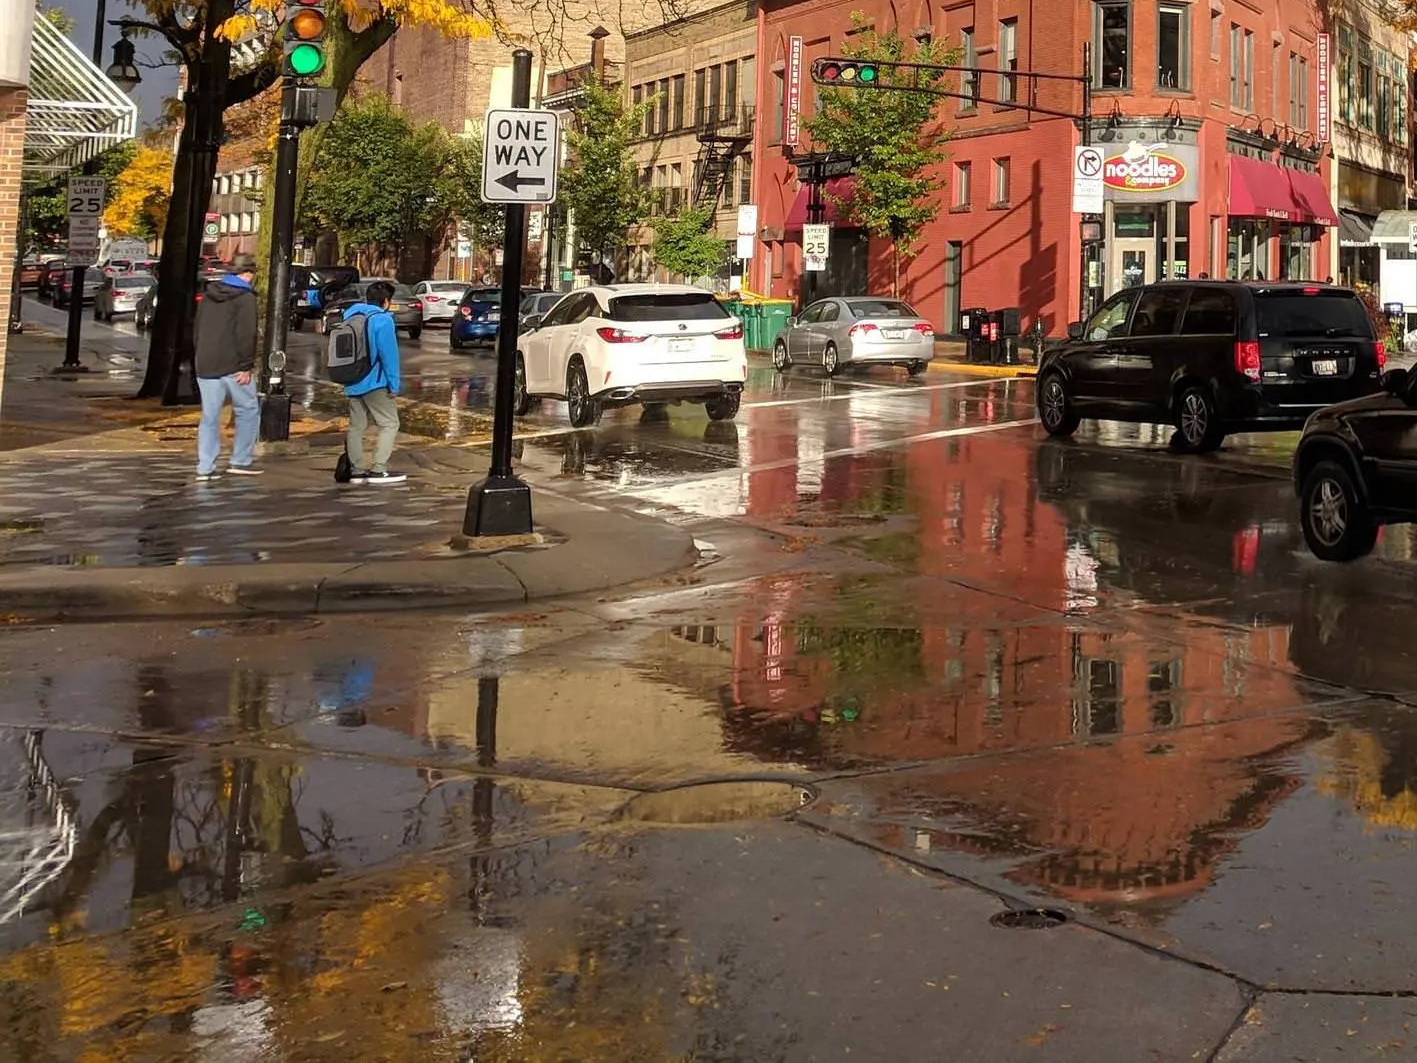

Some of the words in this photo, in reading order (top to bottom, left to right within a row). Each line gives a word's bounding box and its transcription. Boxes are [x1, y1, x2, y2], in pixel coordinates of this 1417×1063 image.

[792, 40, 800, 84] NOODLES
[1319, 38, 1327, 82] NOODLES
[497, 119, 548, 141] ONE
[494, 144, 548, 167] WAY
[1105, 156, 1177, 178] noodles
[69, 198, 101, 213] 25
[806, 242, 826, 254] 25
